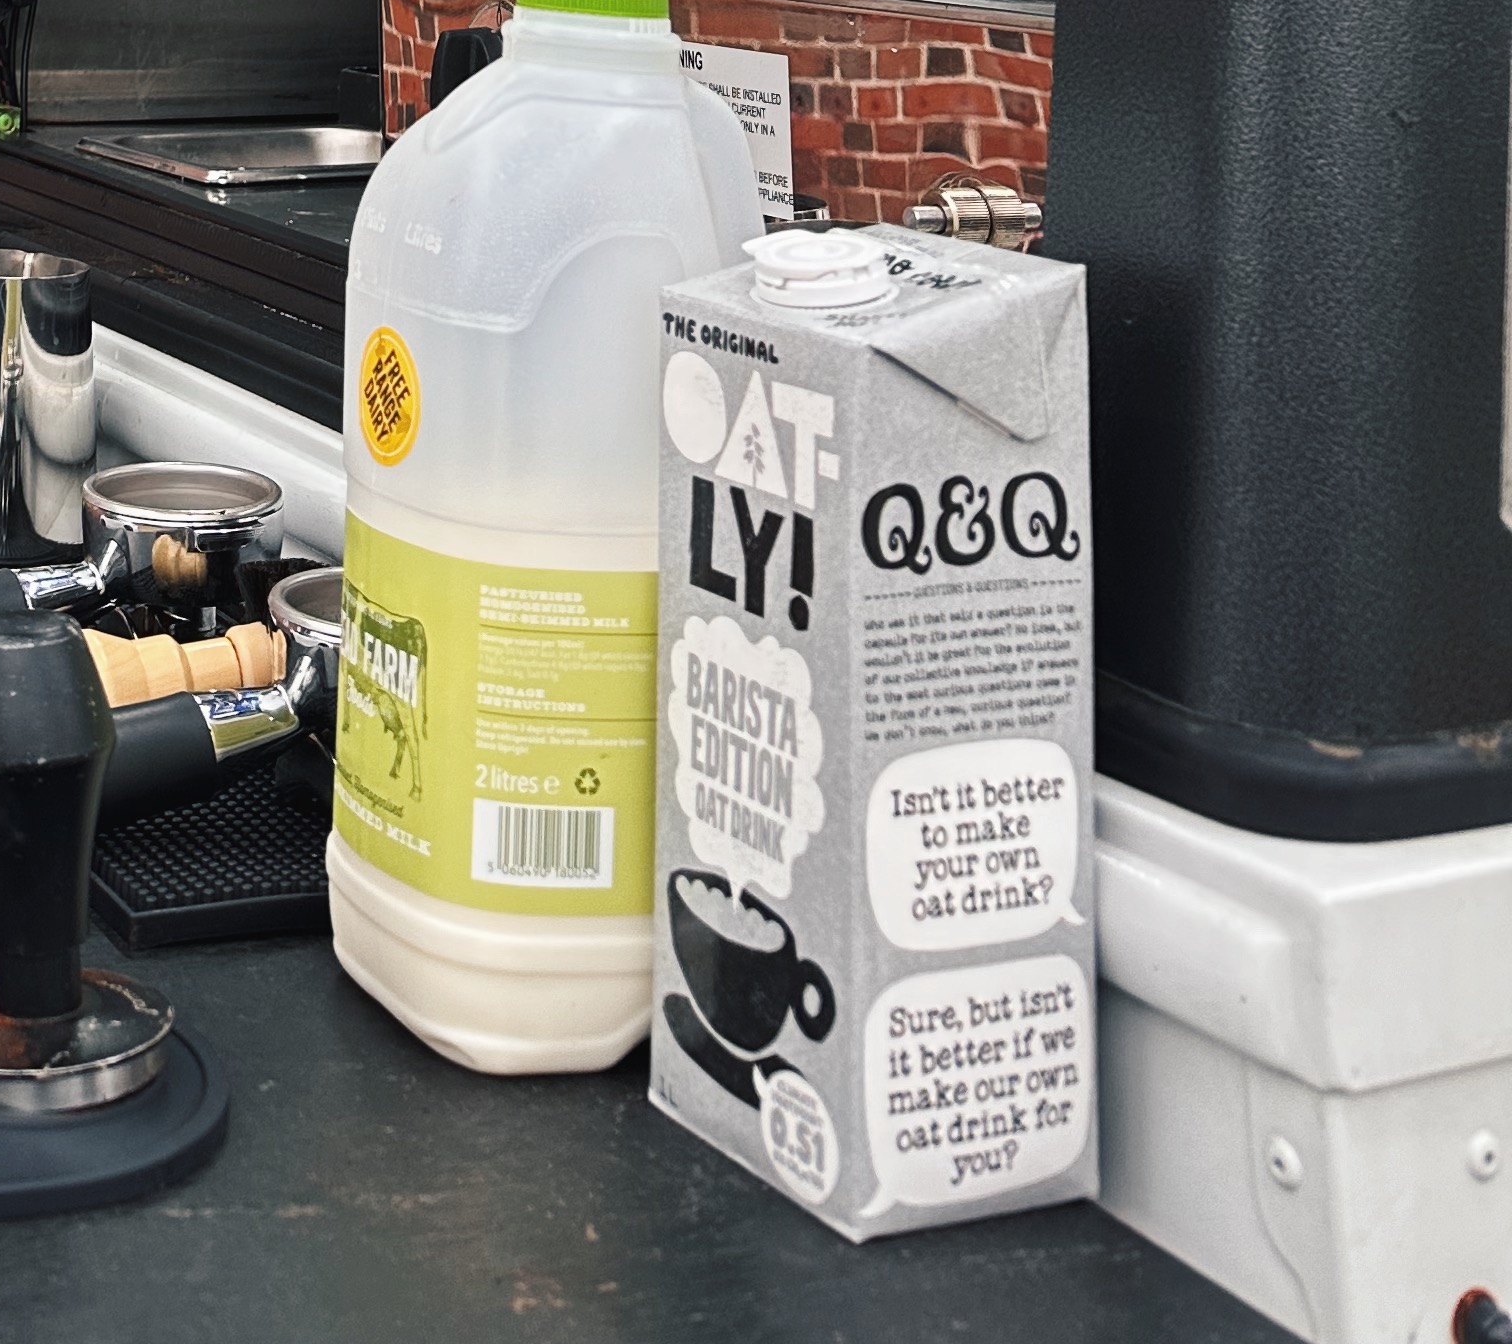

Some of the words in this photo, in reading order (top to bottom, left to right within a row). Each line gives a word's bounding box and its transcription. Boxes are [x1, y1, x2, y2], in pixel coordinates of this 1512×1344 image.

[680, 49, 703, 70] NING
[732, 87, 741, 99] BE
[742, 89, 781, 106] INSTALLED
[761, 122, 769, 136] IN
[769, 124, 776, 137] A
[758, 171, 789, 188] BEFORE
[758, 188, 794, 206] PPLIANCE
[663, 312, 696, 343] THE
[700, 324, 779, 364] ORIGINAL
[373, 357, 401, 433] RANGE
[384, 349, 411, 408] FREE
[364, 377, 389, 442] DAIRY
[861, 471, 1080, 575] Q&Q
[689, 475, 814, 631] LY!
[479, 584, 583, 602] PASTEURISED
[593, 617, 630, 628] MILK
[364, 631, 419, 708] FARM
[477, 682, 546, 699] STORAGE
[477, 694, 586, 713] INSTRUCTIONS
[687, 652, 798, 758] BARISTA
[475, 763, 488, 788] 2
[490, 765, 539, 794] litres
[691, 713, 793, 819] EDITION
[891, 786, 950, 817] Isn't
[957, 782, 976, 811] it
[981, 776, 1065, 808] better
[386, 822, 432, 858] MILK
[695, 782, 729, 832] OAT
[730, 799, 786, 864] DRINK
[921, 822, 948, 849] to
[956, 811, 1031, 845] make
[914, 853, 979, 890] your
[986, 846, 1041, 874] own
[912, 890, 956, 921] oat
[961, 874, 1054, 913] drink?
[889, 1006, 963, 1038] Sure,
[968, 995, 1012, 1027] but
[1020, 983, 1074, 1018] isn't
[889, 1050, 912, 1078] it
[919, 1039, 1006, 1074] better
[1012, 1027, 1035, 1060] if
[1040, 1026, 1075, 1054] we
[889, 1078, 968, 1116] make
[974, 1074, 1020, 1102] our
[1026, 1063, 1079, 1093] own
[770, 1107, 825, 1173] 0.51
[896, 1120, 942, 1152] oat
[947, 1104, 1027, 1144] drink
[1035, 1098, 1072, 1129] for
[951, 1139, 1019, 1185] you?
